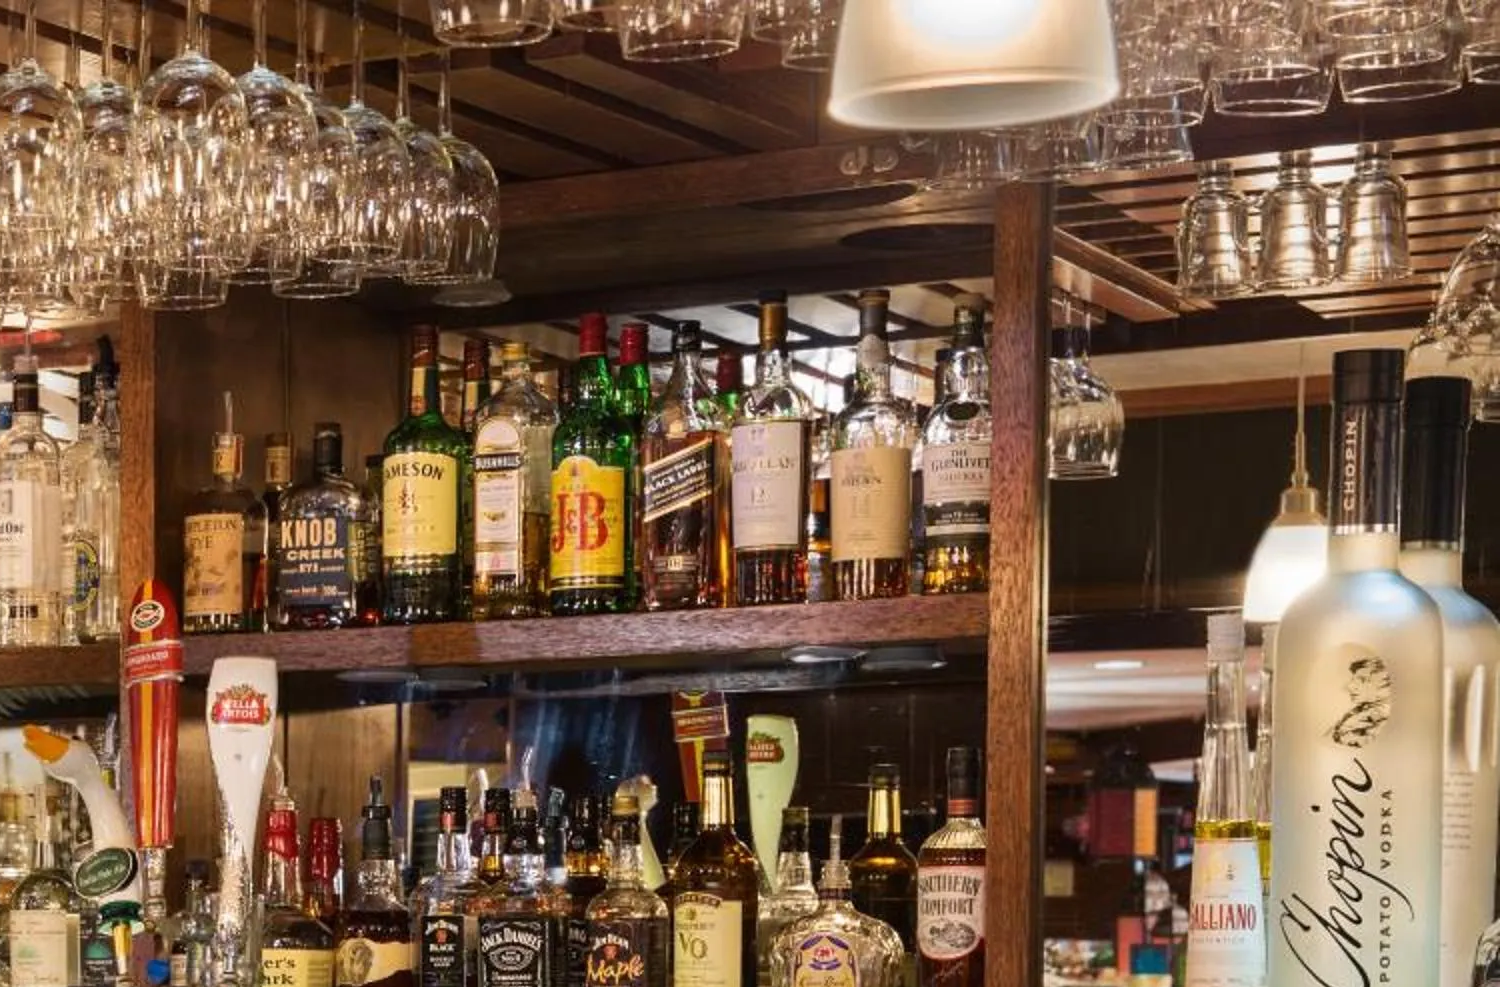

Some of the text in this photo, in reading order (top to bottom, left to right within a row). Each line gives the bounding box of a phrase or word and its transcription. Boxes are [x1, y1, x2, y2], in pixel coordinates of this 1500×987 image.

[384, 461, 445, 481] AMESON
[1343, 420, 1358, 512] CHOPIN
[281, 517, 337, 549] KNOB
[286, 548, 345, 561] CREEK
[1379, 789, 1394, 983] POTATO VODKA
[1191, 902, 1257, 931] ALLIANO
[429, 943, 455, 952] BLACK
[481, 932, 507, 952] JACK
[262, 956, 297, 970] er's
[586, 954, 645, 986] Maple
[261, 972, 295, 986] ark
